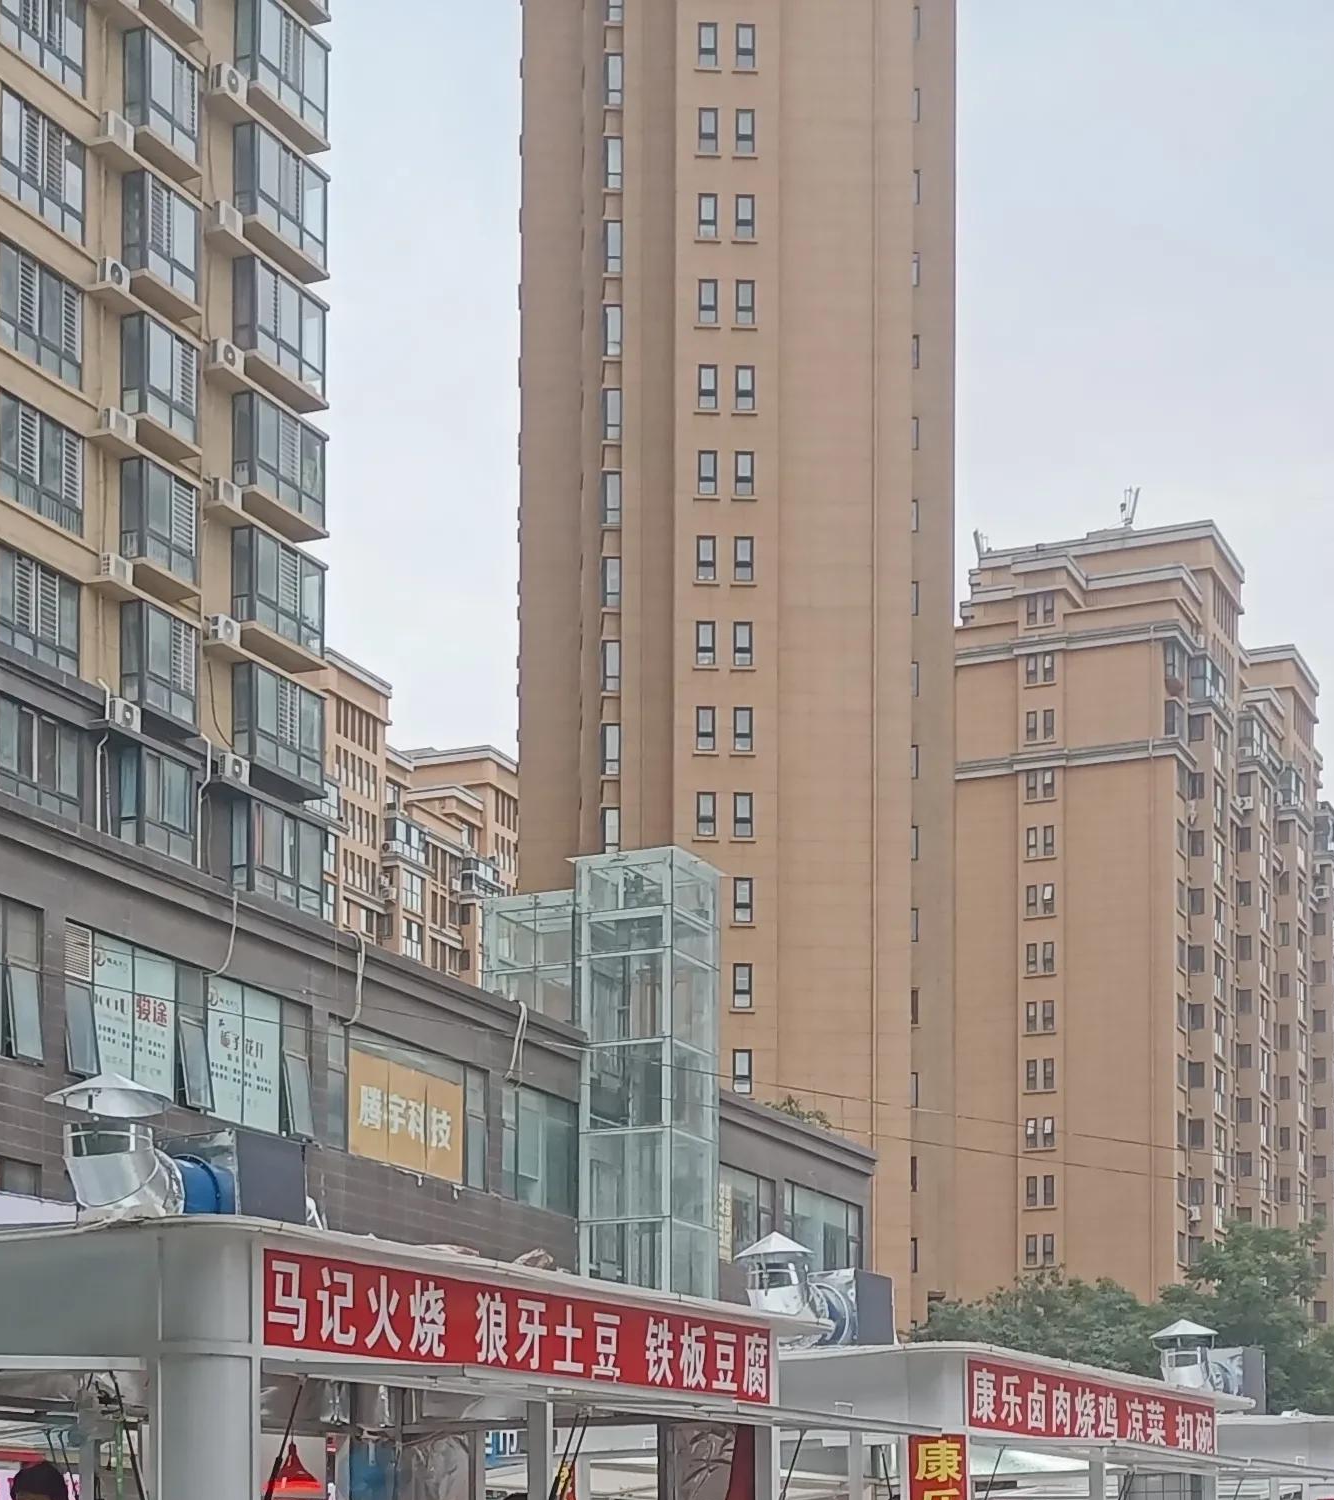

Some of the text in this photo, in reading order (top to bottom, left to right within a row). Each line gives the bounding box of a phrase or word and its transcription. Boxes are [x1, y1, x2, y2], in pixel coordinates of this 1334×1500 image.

[267, 1259, 768, 1399] 马记火烧 狼牙土豆 铁板豆腐
[971, 1367, 1215, 1456] 康乐卤肉烧鸡 凉菜 扣碗
